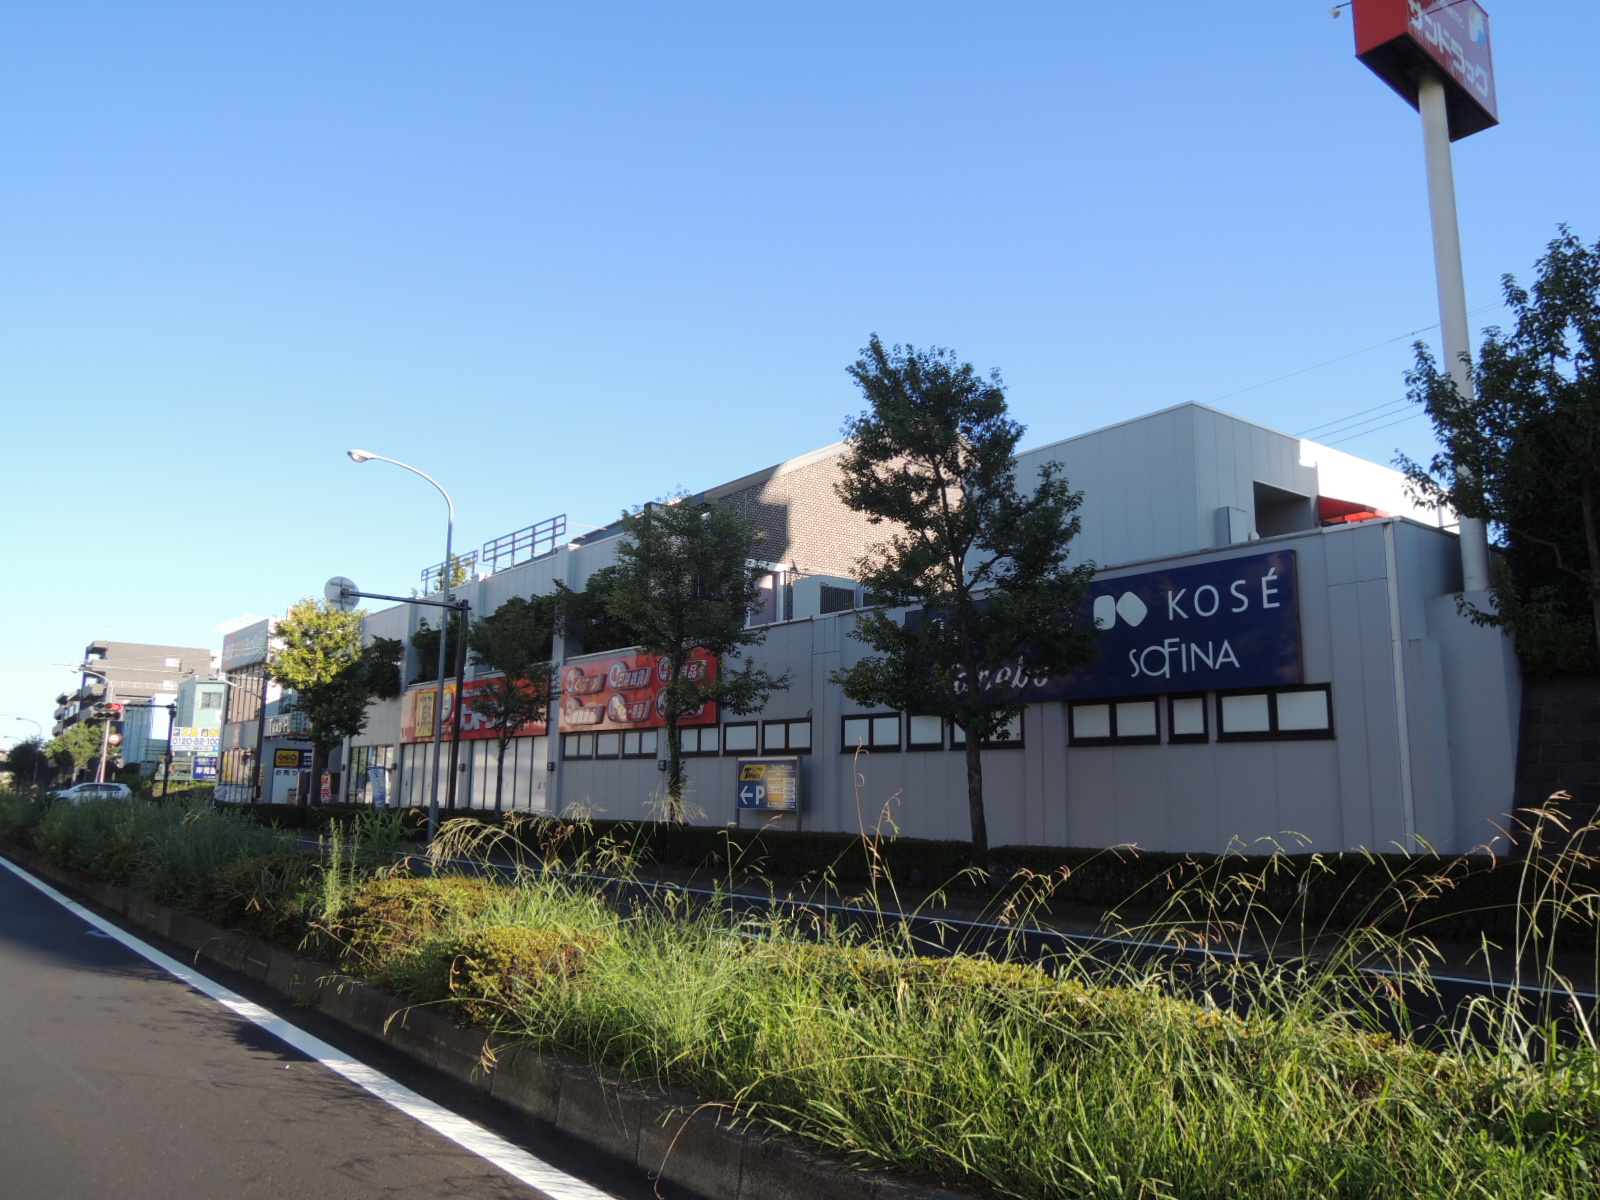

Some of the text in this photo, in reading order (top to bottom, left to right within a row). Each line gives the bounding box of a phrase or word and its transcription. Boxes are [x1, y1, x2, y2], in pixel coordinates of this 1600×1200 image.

[1167, 567, 1281, 620] KOSÉ
[1129, 637, 1241, 679] SOFINA
[755, 785, 766, 805] P
